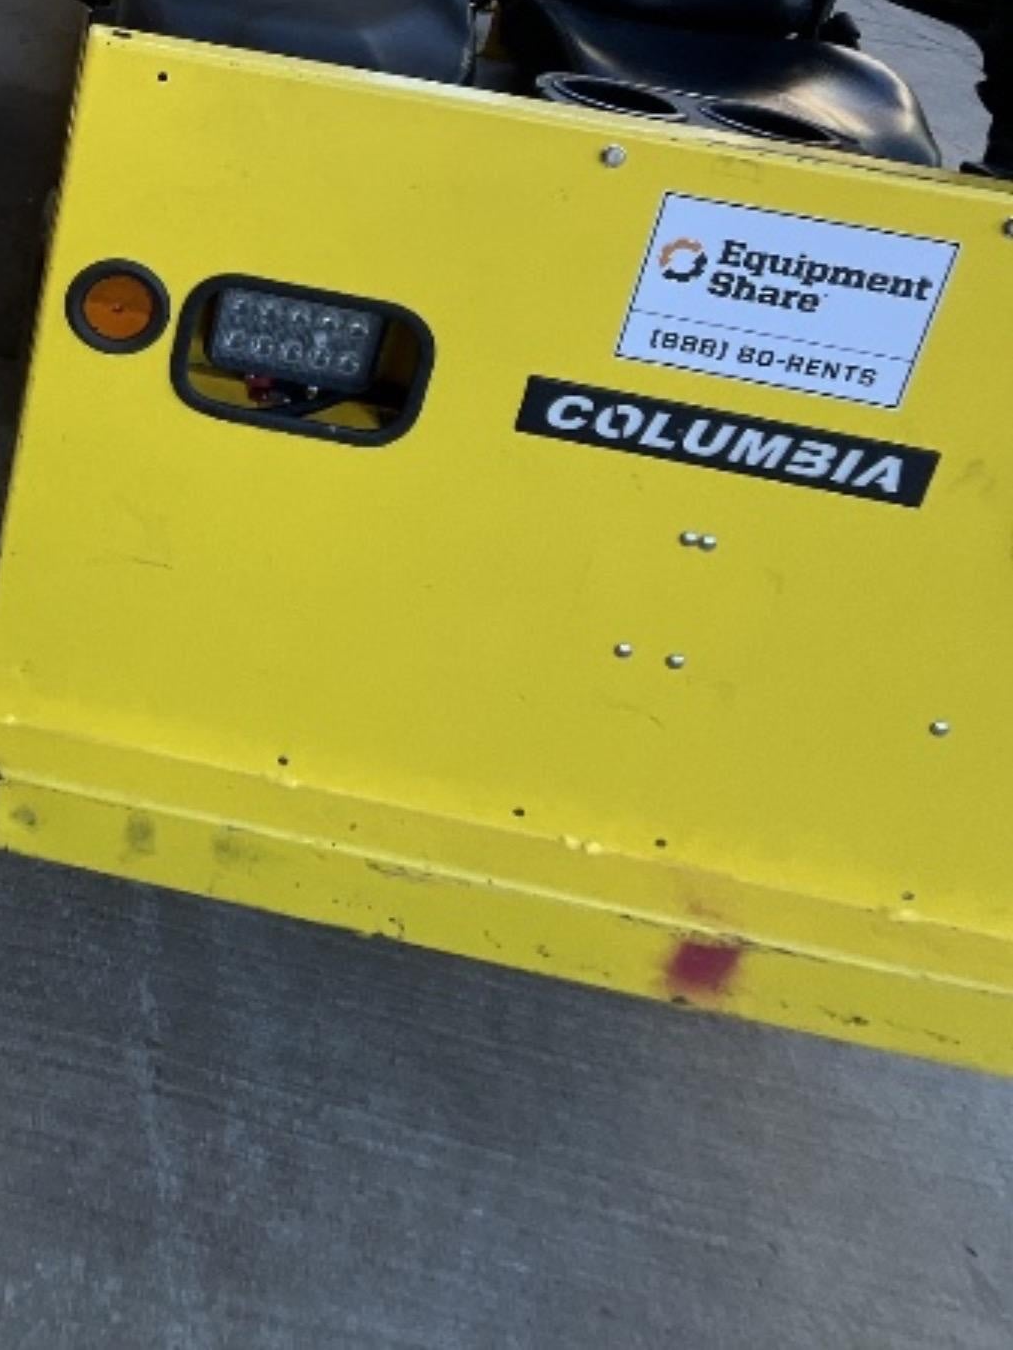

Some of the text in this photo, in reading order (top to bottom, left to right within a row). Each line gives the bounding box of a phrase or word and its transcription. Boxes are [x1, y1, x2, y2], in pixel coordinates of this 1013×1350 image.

[706, 271, 821, 313] Share
[717, 239, 933, 302] Equipment
[736, 344, 877, 387] 80-RENTS
[546, 394, 904, 493] COLUMBIA
